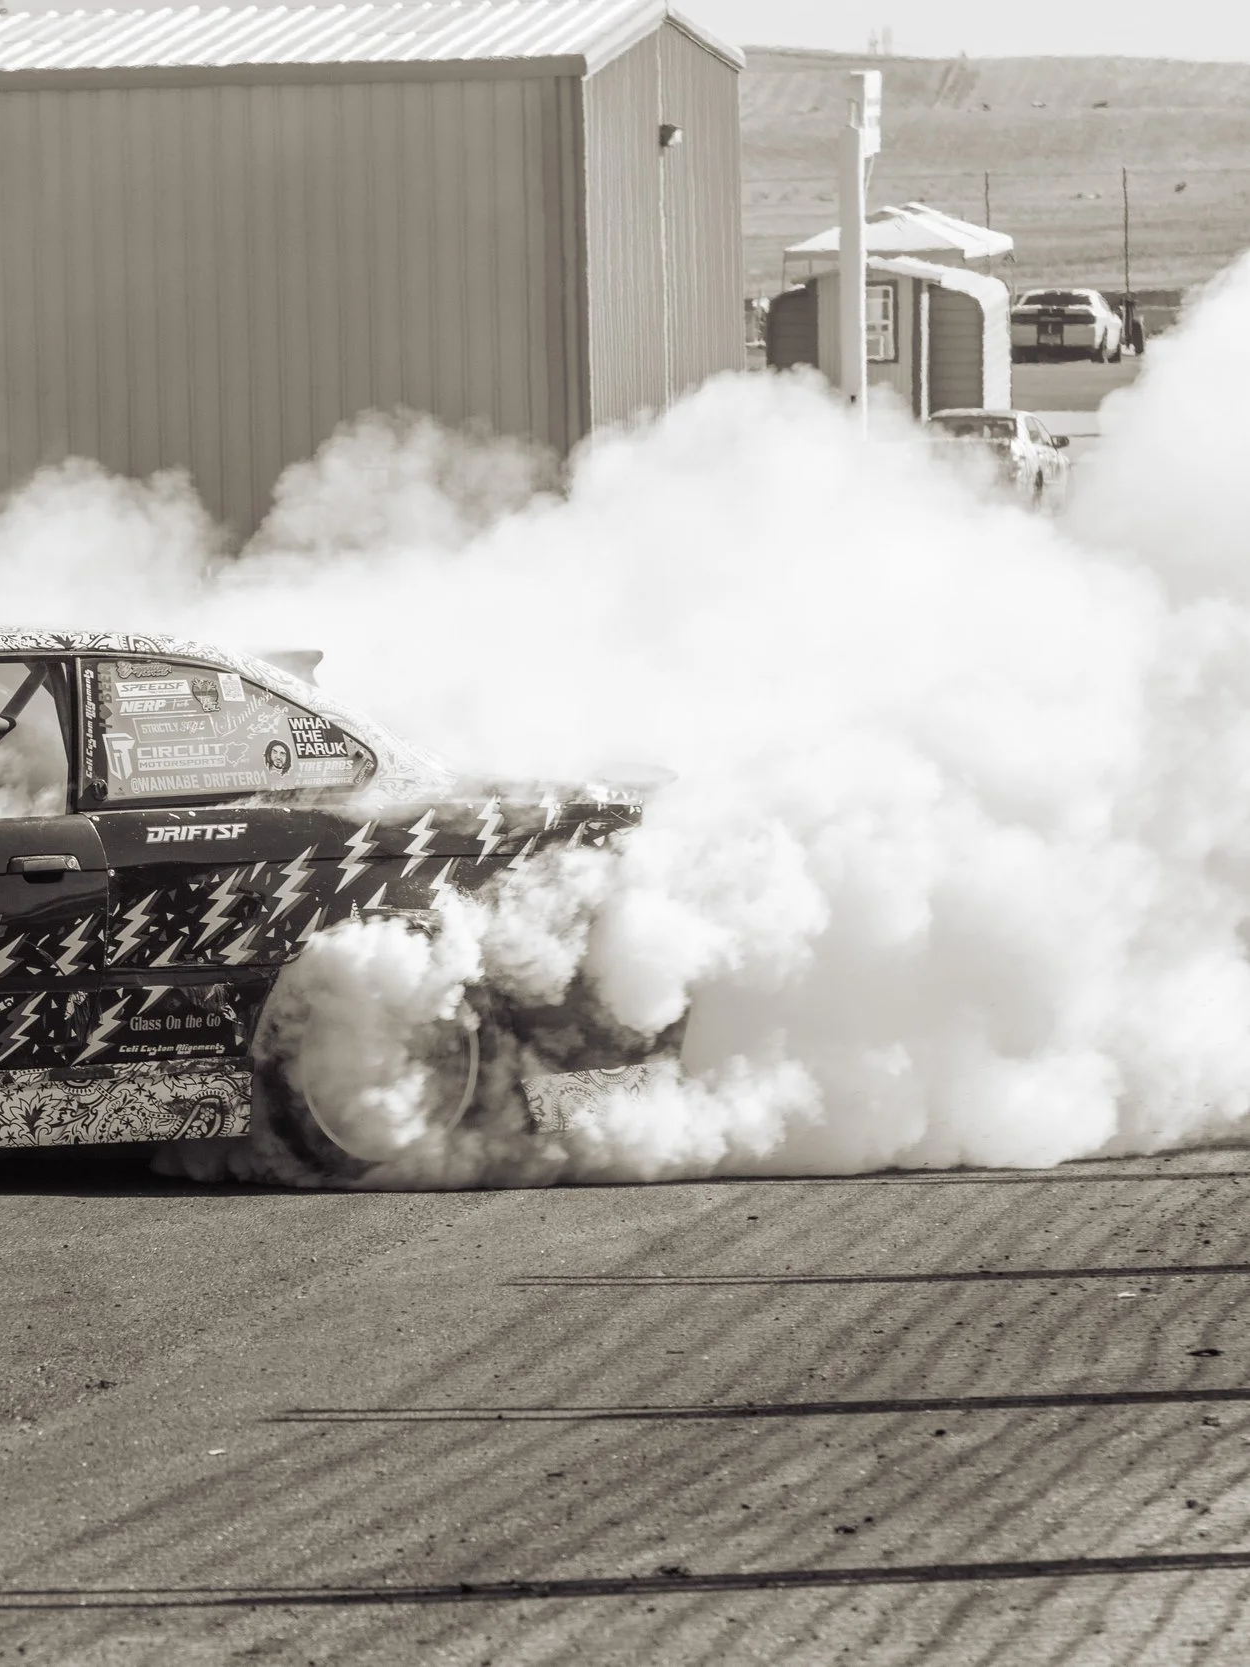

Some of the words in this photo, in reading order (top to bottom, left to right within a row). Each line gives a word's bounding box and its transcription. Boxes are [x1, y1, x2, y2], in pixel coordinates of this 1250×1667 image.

[119, 699, 167, 713] NERP
[140, 721, 179, 734] STRICTLY
[288, 717, 331, 730] WHAT
[291, 730, 324, 742] THE
[137, 743, 225, 759] CIRCUIT
[295, 741, 348, 756] FARUK
[139, 757, 225, 770] MOTORSPORTS
[145, 823, 248, 844] DRIFTSF
[130, 1016, 162, 1031] Glass
[165, 1014, 181, 1030] On
[185, 1014, 203, 1029] the
[206, 1013, 221, 1027] Go
